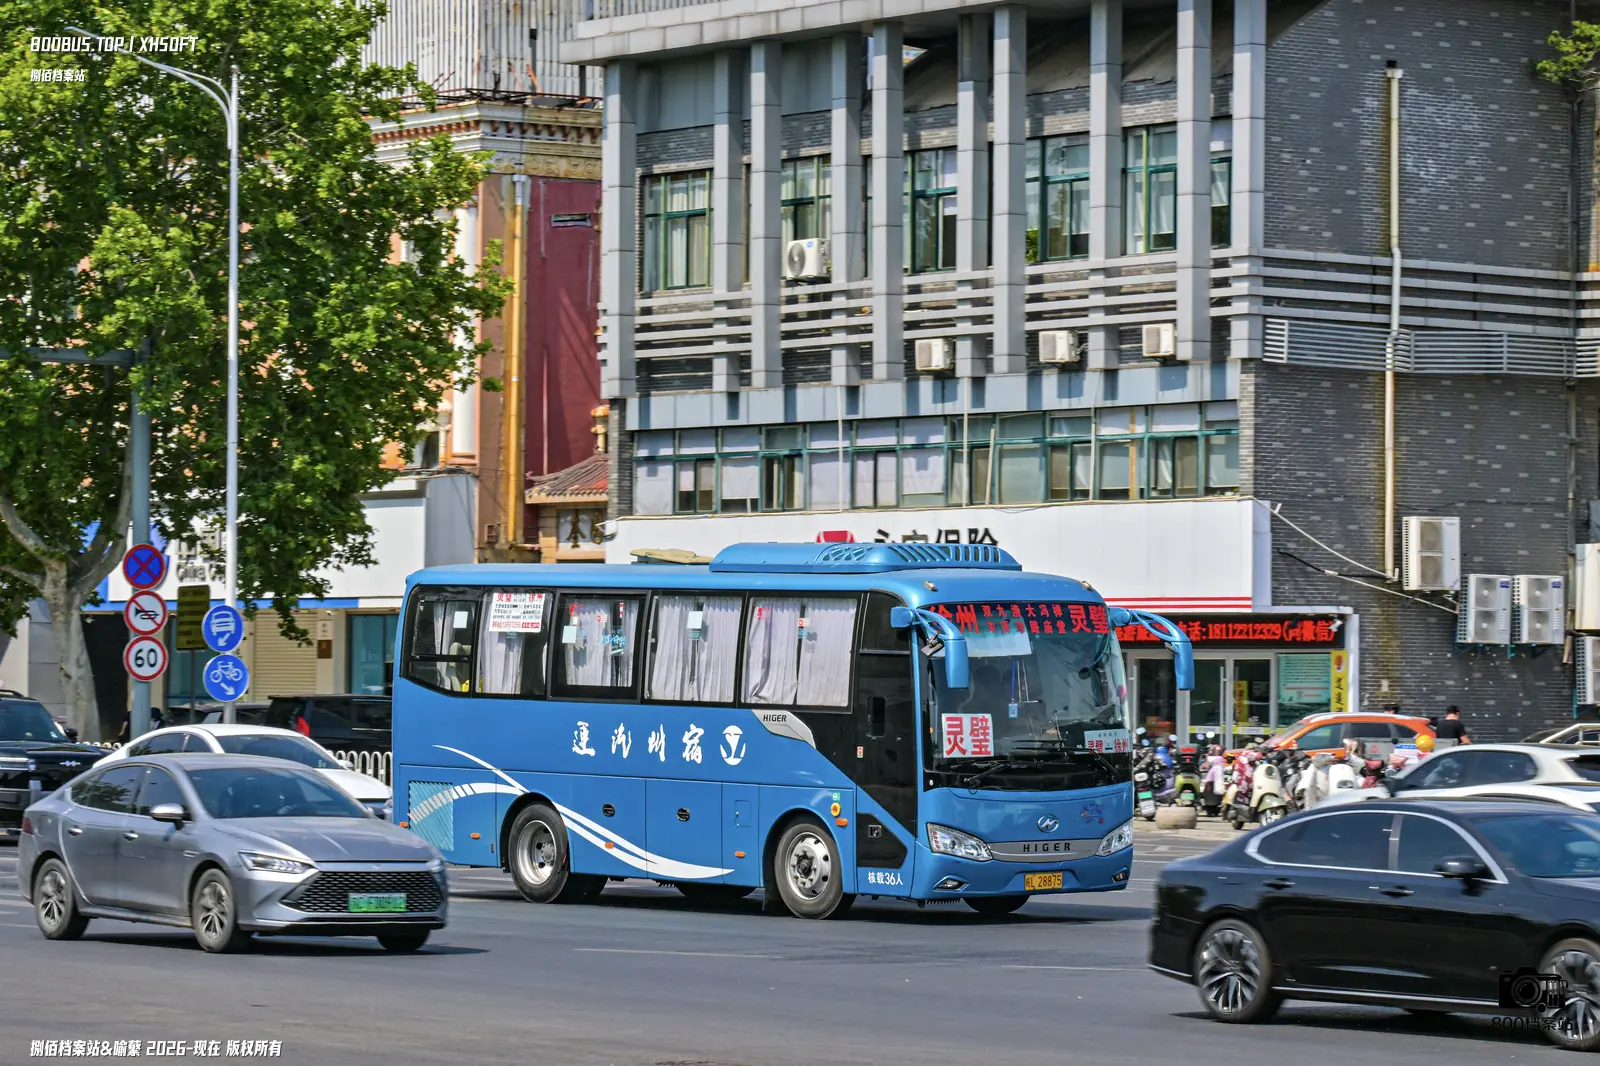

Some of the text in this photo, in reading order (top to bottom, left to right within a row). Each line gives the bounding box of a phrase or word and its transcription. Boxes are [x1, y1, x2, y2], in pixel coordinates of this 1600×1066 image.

[134, 648, 158, 668] 60
[763, 714, 787, 723] HIGER
[1023, 843, 1071, 853] HIGER
[868, 871, 904, 886] 核载36人
